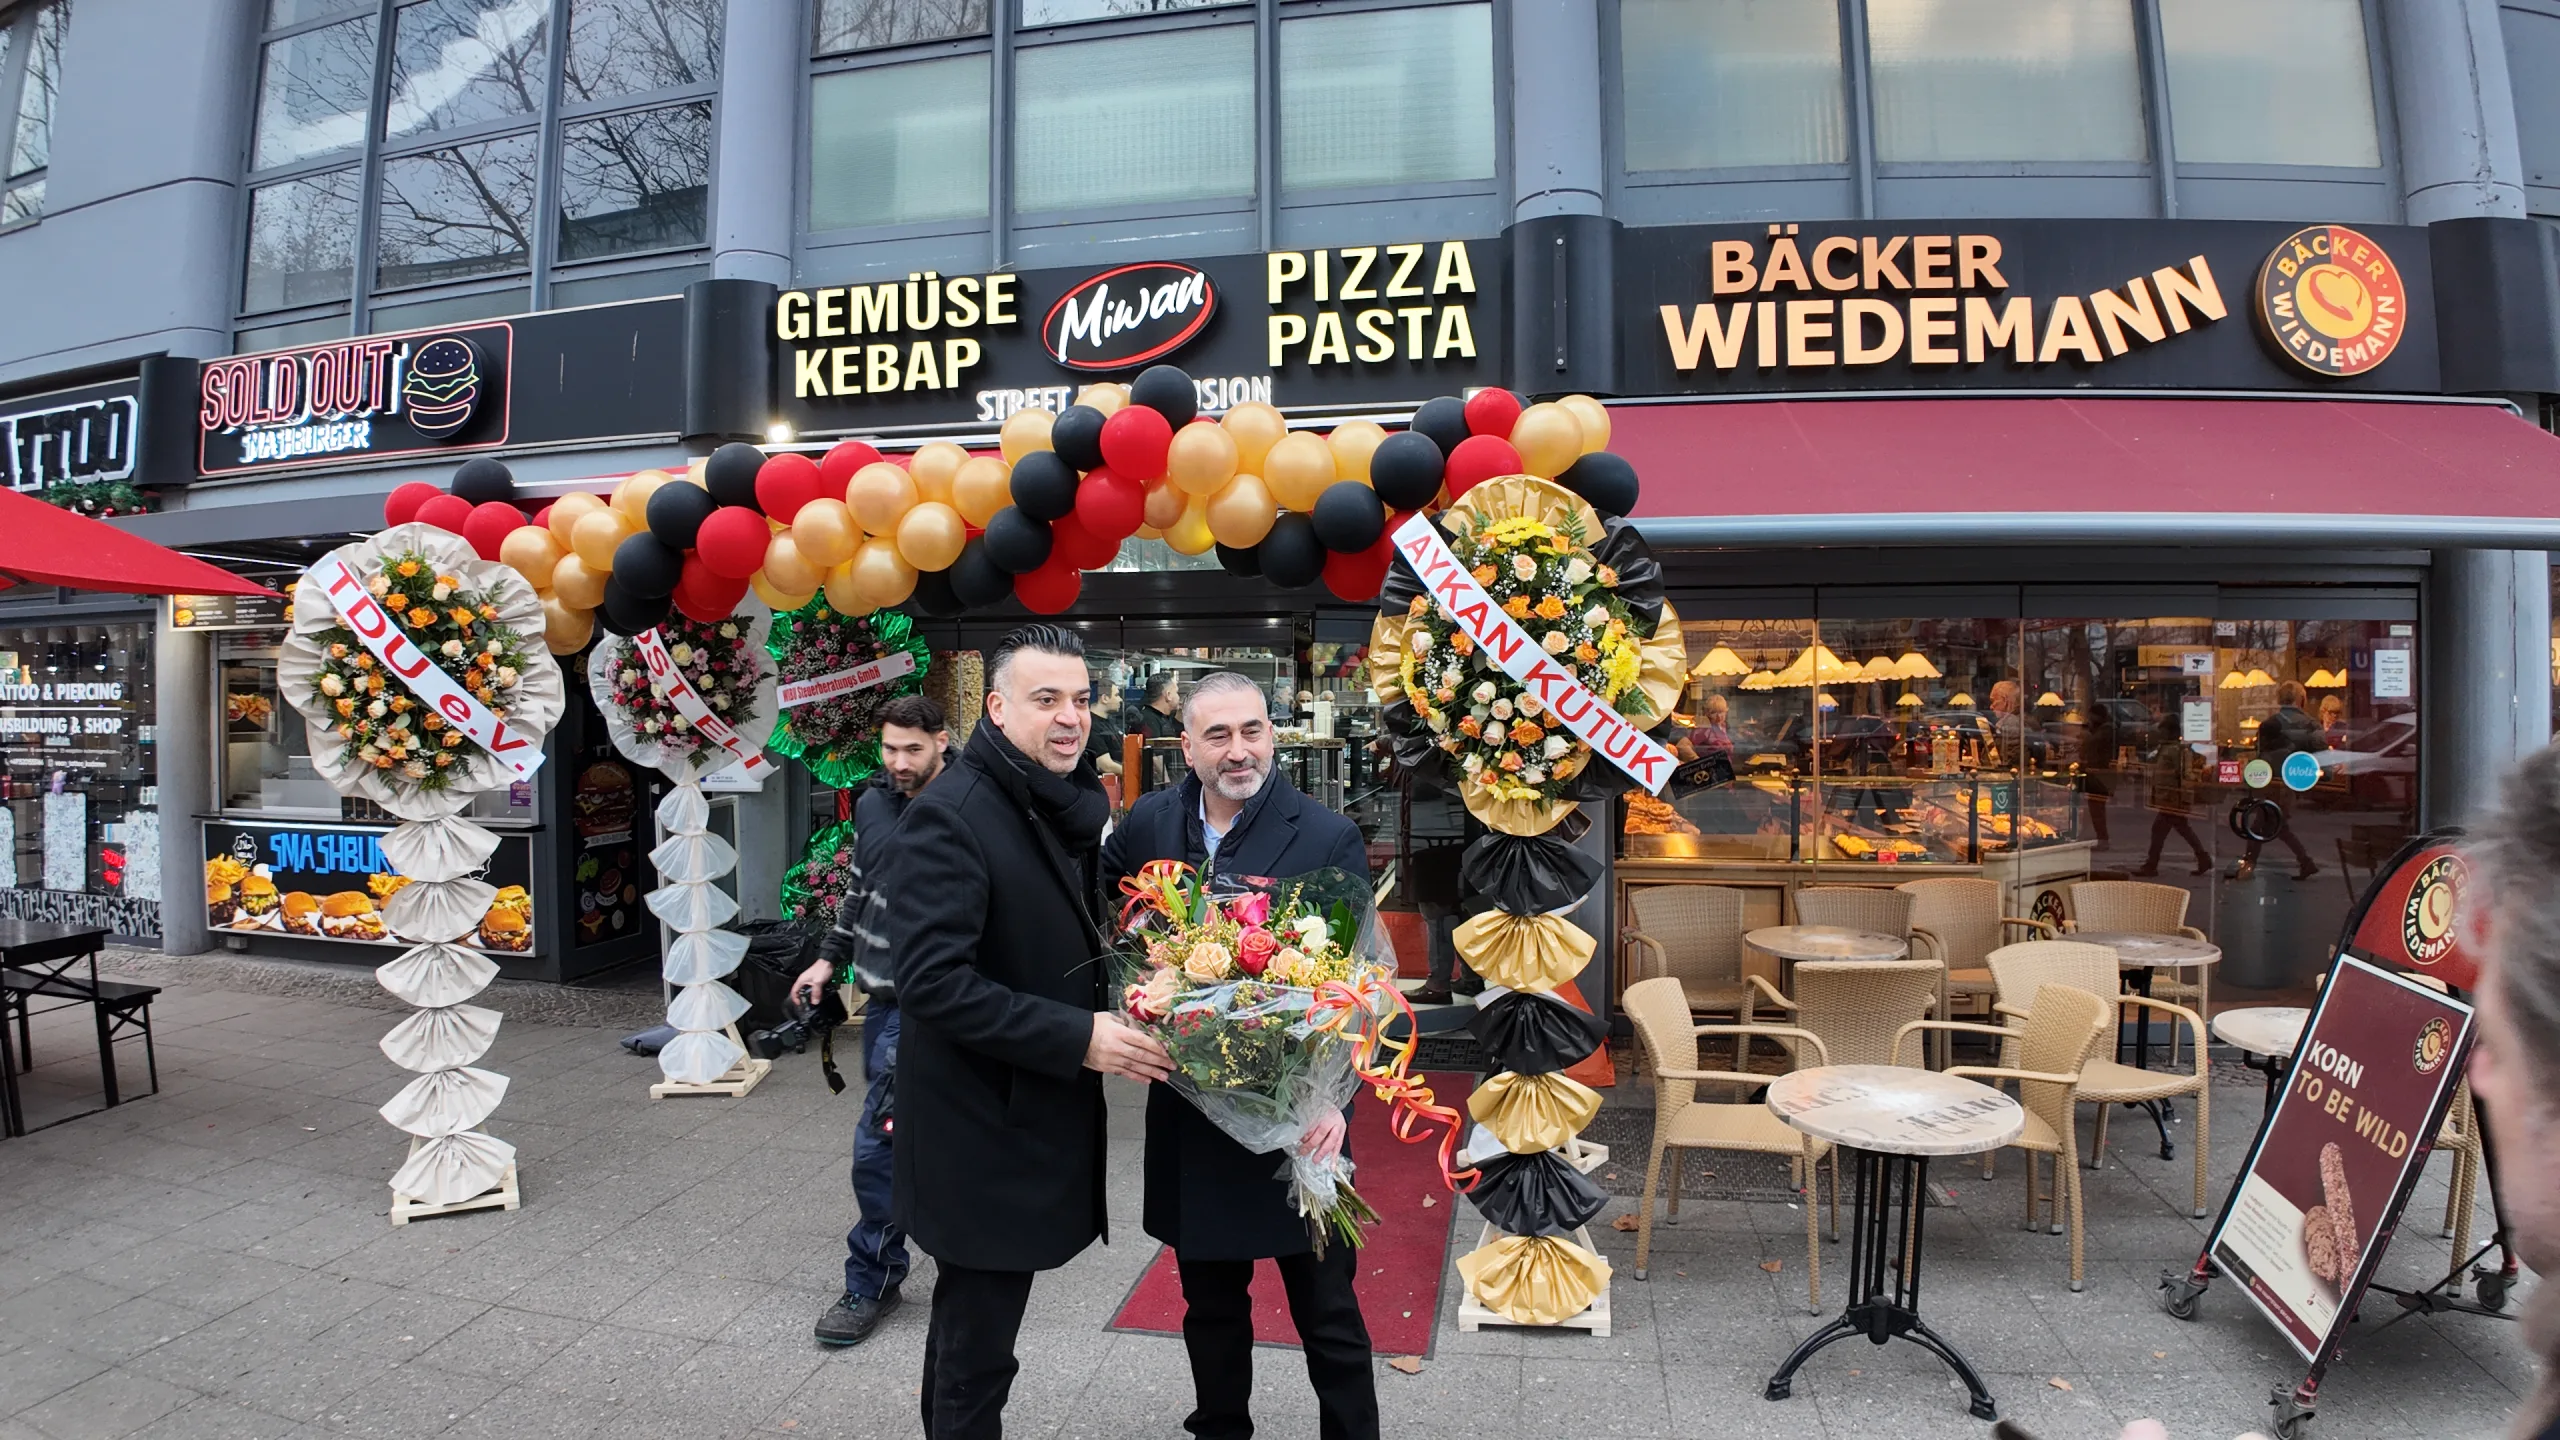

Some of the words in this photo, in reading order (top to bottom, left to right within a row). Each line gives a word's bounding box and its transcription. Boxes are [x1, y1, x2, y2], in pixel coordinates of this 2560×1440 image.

[1267, 241, 1476, 304] PIZZA
[1711, 224, 2009, 296] BÄCKER
[2277, 235, 2386, 283] BÄCKER
[776, 270, 1018, 341] GEMÜSE
[1058, 271, 1206, 363] Miwan
[1268, 305, 1477, 367] PASTA
[1660, 254, 2228, 370] WIEDEMANN
[2273, 291, 2397, 367] WIEDEMANN
[201, 355, 299, 430] SOLD
[310, 341, 394, 416] OUT
[795, 338, 981, 398] KEBAP
[976, 385, 1071, 422] STREET
[43, 683, 53, 701] &
[57, 682, 122, 701] PIERCING
[328, 561, 431, 679] TDU
[439, 693, 529, 772] e.V.
[797, 673, 858, 698] Steuerberatungs
[857, 664, 881, 683] GmbH
[1403, 534, 1525, 664] AYKAN
[1525, 659, 1669, 785] KÜTÜK
[70, 716, 81, 735] &
[85, 717, 122, 734] SHOP
[2307, 1039, 2365, 1090] KORN
[2297, 1069, 2323, 1102] TO
[2324, 1087, 2355, 1124] BE
[2355, 1105, 2408, 1159] WILD
